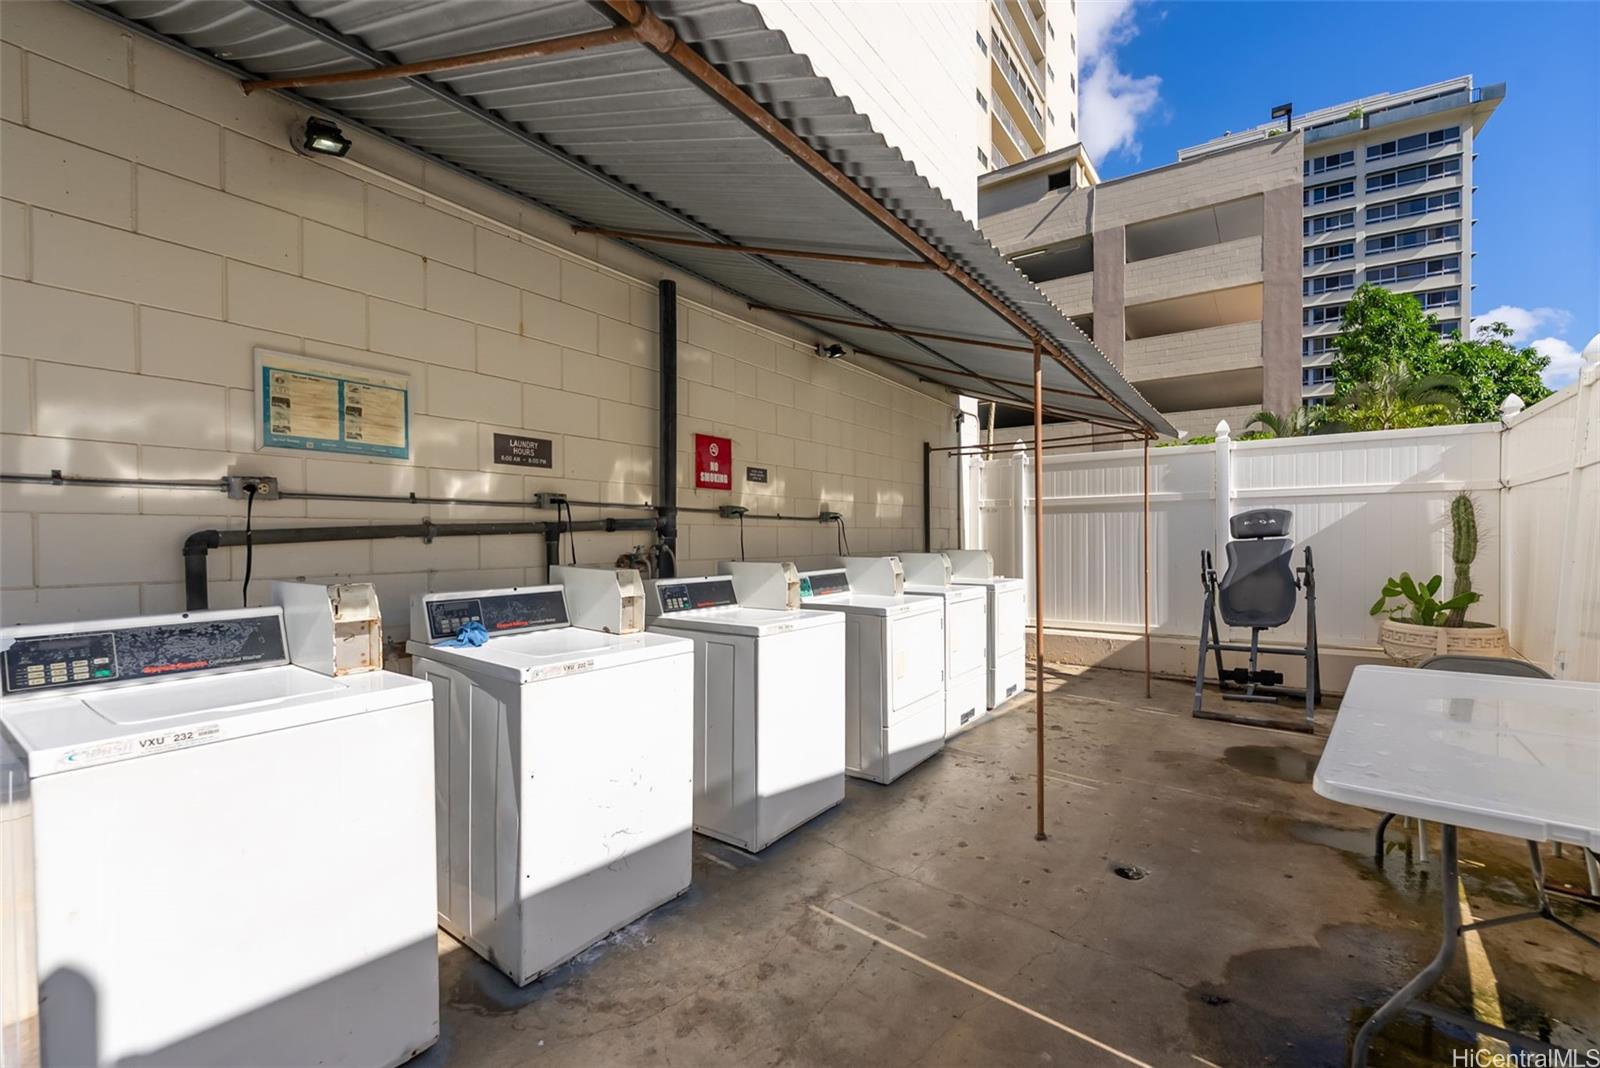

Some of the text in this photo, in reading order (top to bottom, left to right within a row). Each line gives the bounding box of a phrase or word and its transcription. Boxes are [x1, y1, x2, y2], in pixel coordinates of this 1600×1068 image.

[509, 439, 539, 449] LAUNDRY
[512, 447, 536, 457] HOURS
[709, 461, 719, 472] NO
[700, 471, 729, 484] SMOKING
[139, 731, 194, 748] VXU 232
